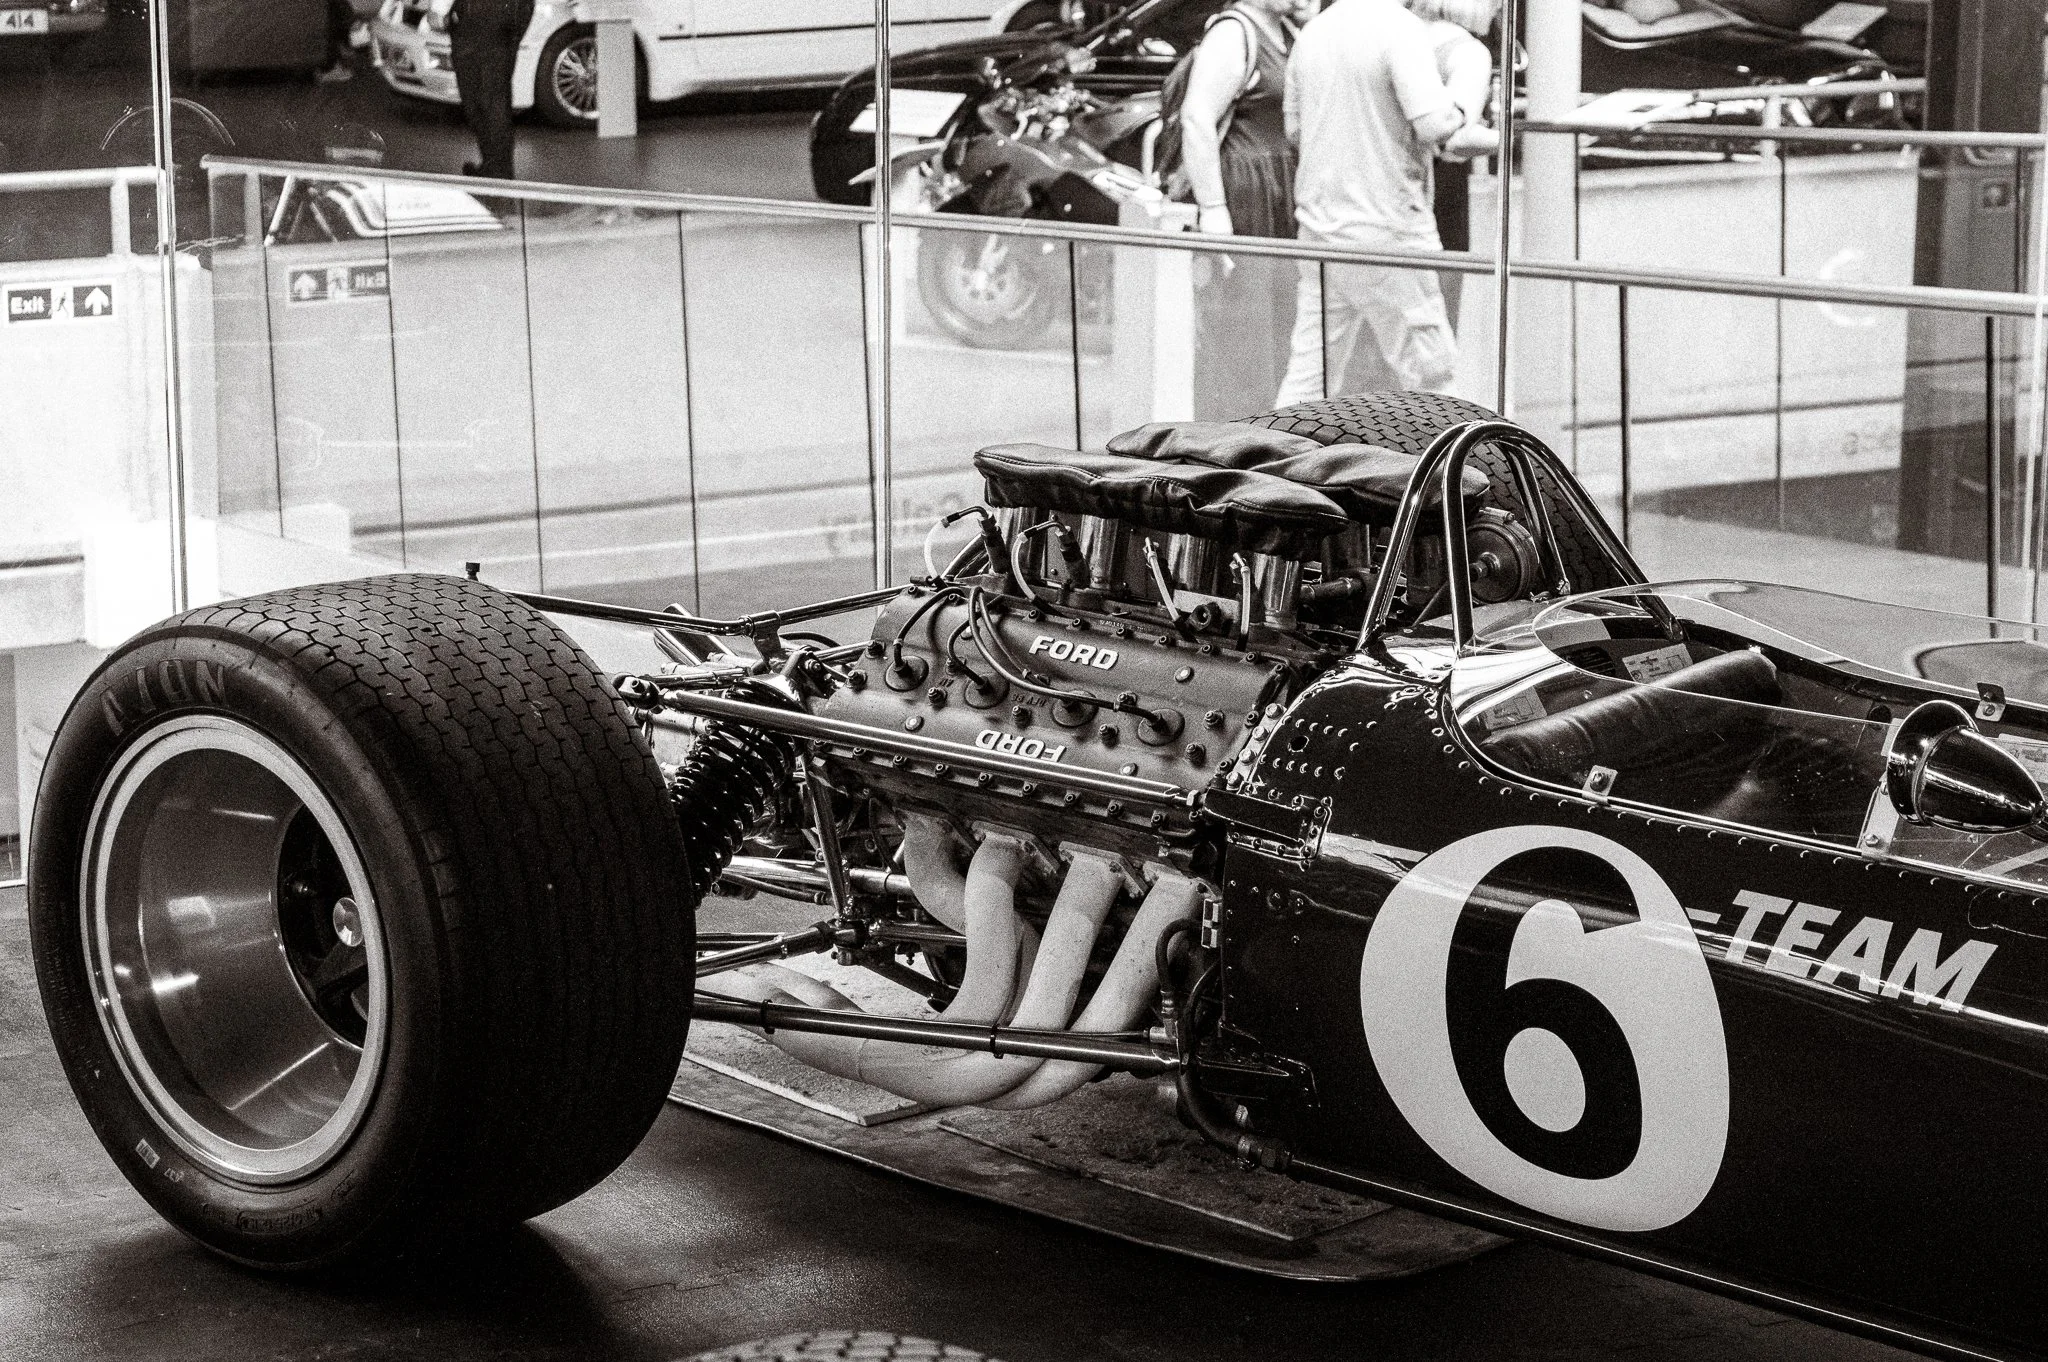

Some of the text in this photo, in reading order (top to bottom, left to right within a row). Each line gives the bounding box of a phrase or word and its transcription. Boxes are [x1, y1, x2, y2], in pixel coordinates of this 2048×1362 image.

[10, 295, 45, 315] Exit
[1028, 635, 1119, 670] FORD
[975, 729, 1067, 762] FORD
[1444, 845, 1643, 1181] 6
